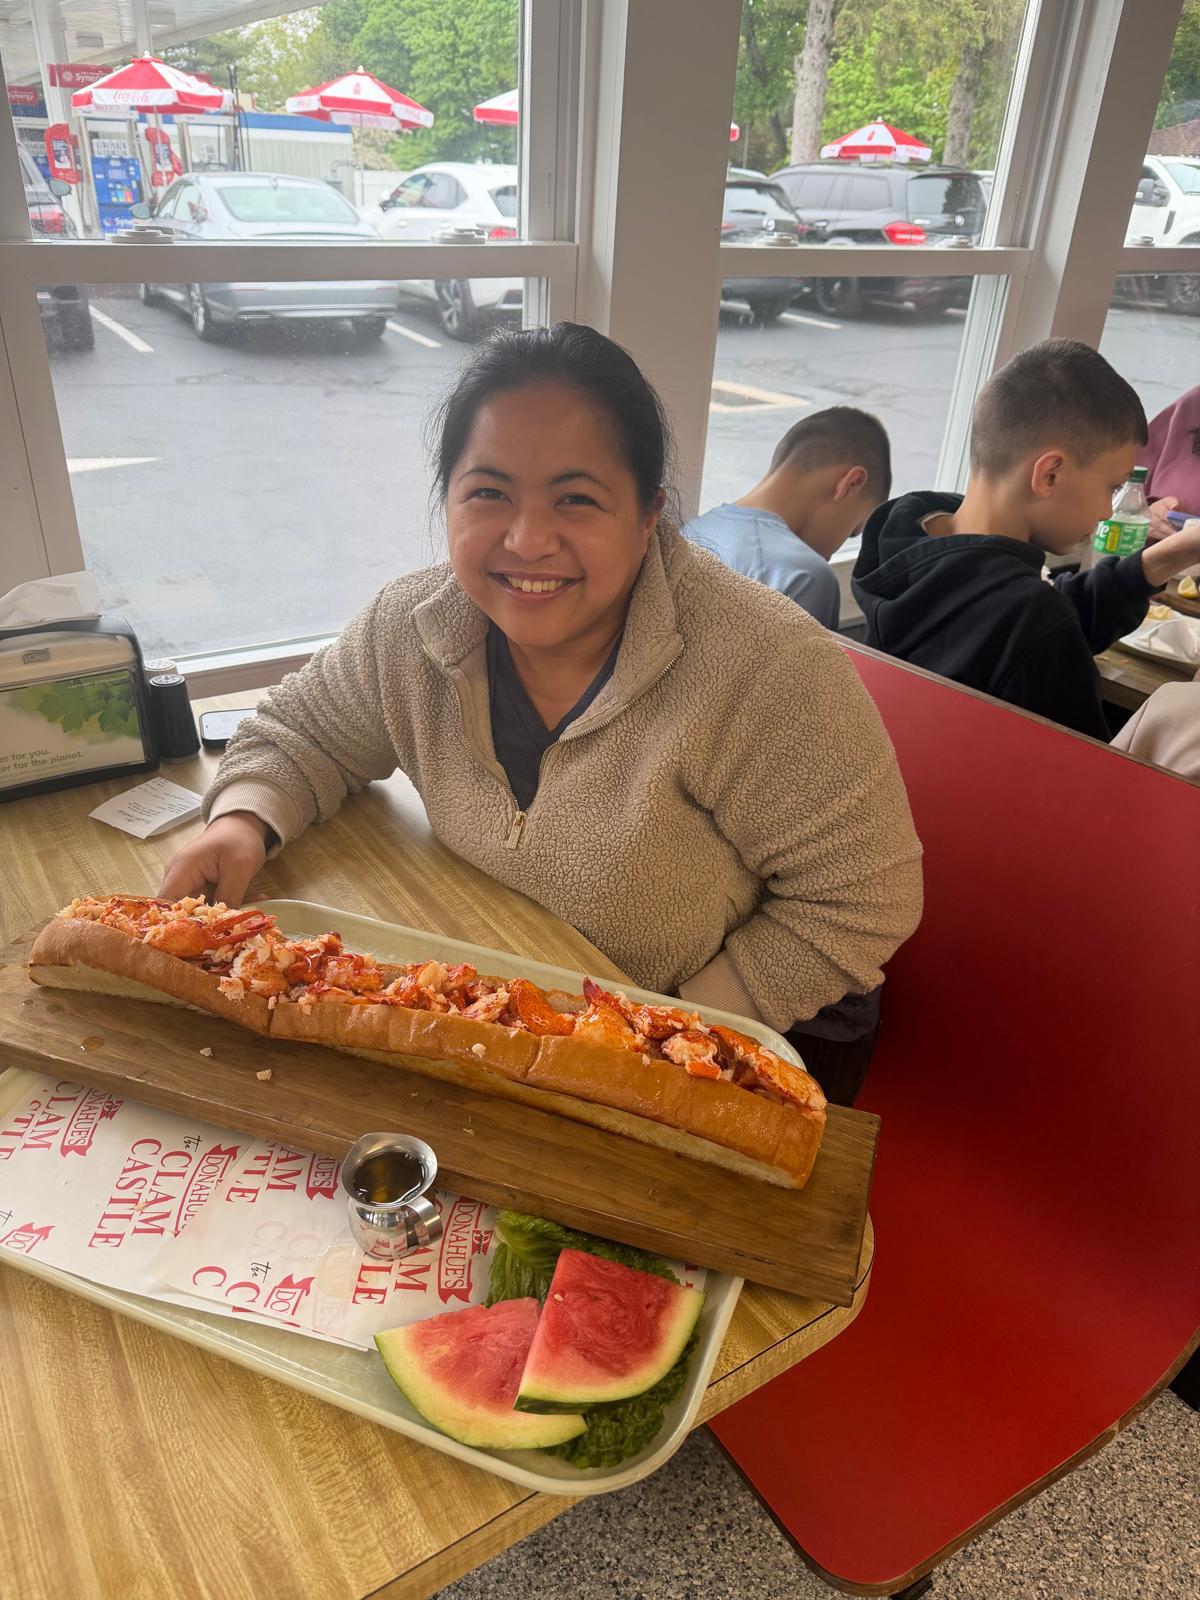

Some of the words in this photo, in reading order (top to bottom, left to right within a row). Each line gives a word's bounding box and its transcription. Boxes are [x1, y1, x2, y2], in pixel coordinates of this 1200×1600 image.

[31, 758, 48, 768] the
[21, 1080, 80, 1151] CLAM
[88, 1138, 162, 1248] CASTLE
[131, 1150, 193, 1237] CLAM
[444, 1202, 478, 1289] DONAHUE'S
